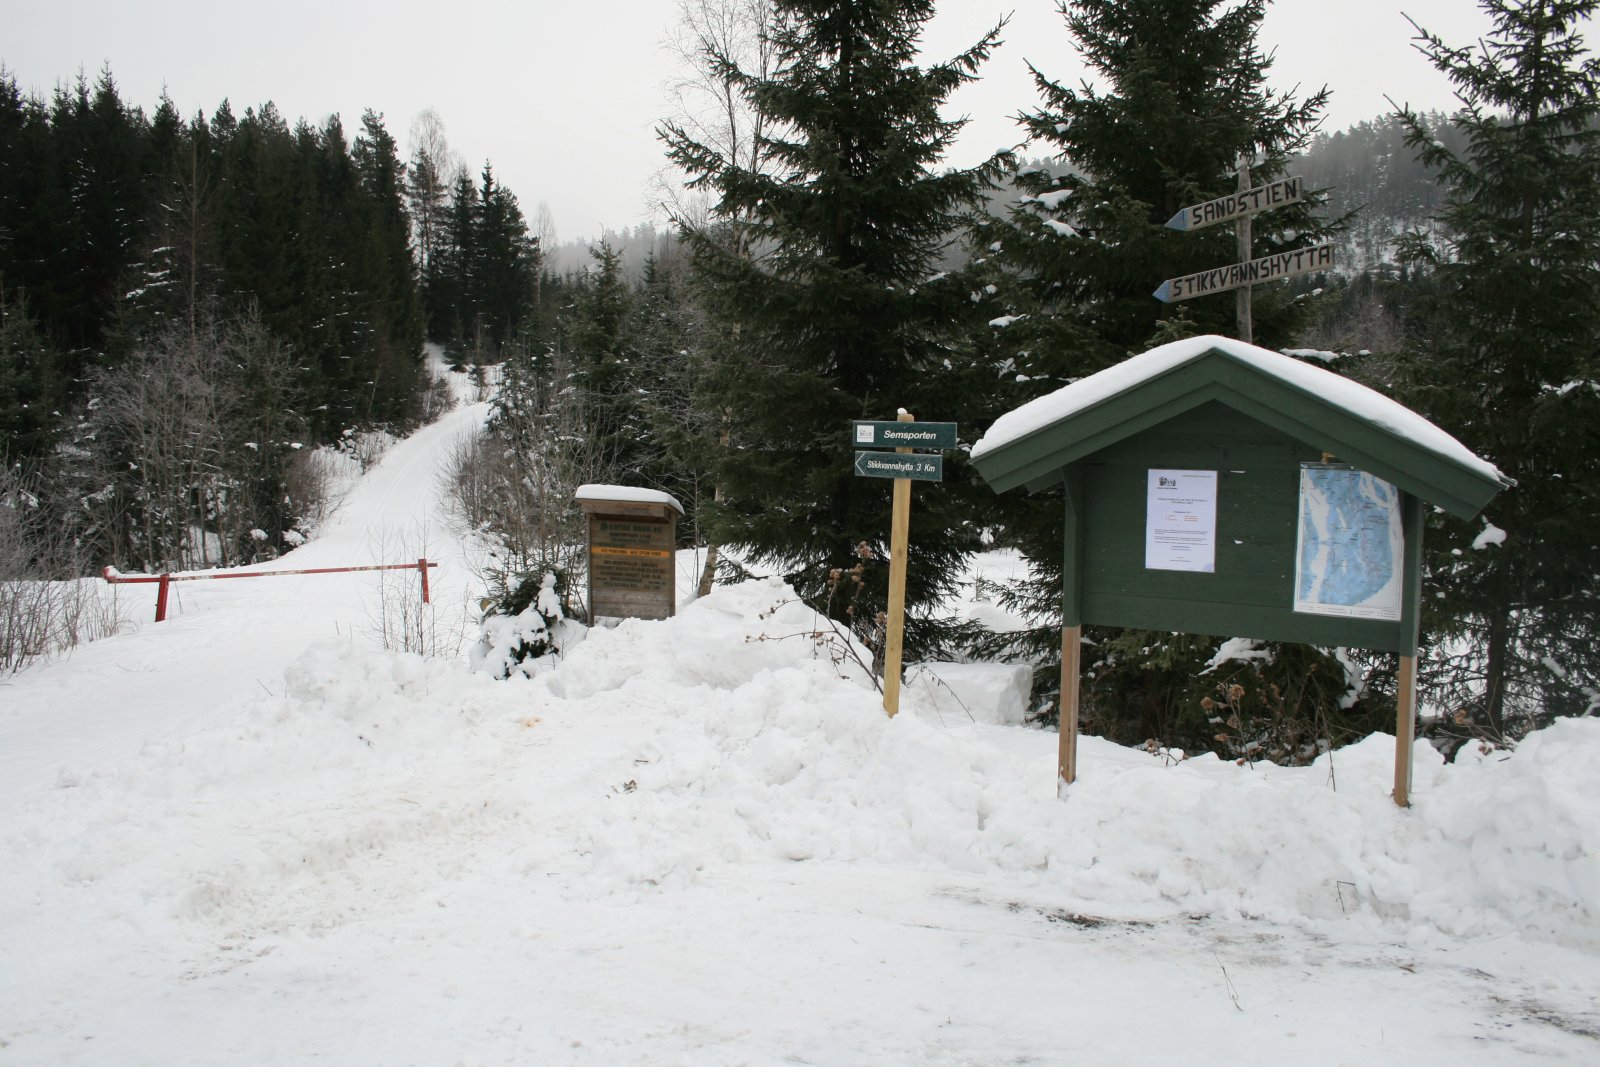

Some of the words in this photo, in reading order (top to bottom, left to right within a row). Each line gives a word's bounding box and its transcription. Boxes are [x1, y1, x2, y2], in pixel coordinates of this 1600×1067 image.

[1192, 179, 1297, 225] SANDSTIEN
[1173, 245, 1331, 297] STIKKVANNSHYTTA
[884, 430, 937, 441] Semsporten
[916, 463, 921, 472] 3
[924, 464, 935, 473] Km
